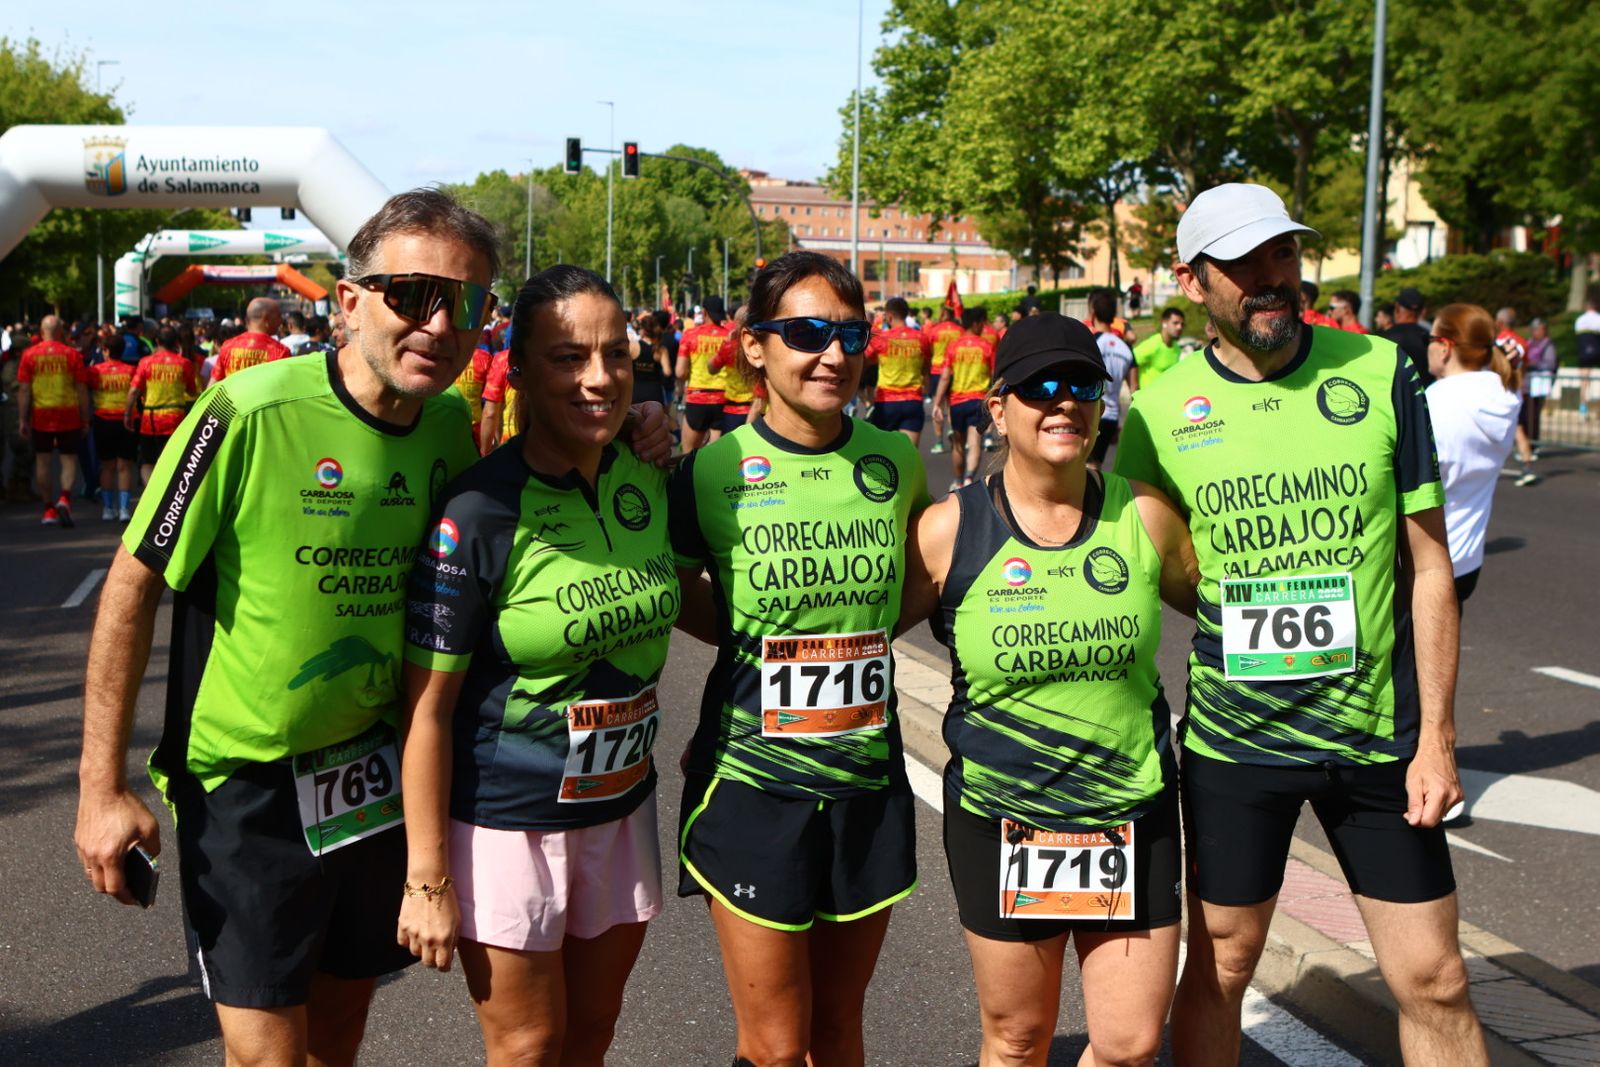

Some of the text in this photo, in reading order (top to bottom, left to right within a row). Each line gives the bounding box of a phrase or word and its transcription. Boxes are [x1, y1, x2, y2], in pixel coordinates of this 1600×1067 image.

[136, 154, 259, 175] Ayuntamiento
[138, 177, 260, 194] de Salamanca
[1171, 419, 1226, 437] CARBAJOSA
[154, 415, 219, 547] CORRECAMINOS
[723, 481, 788, 494] CARBAJOSA
[744, 489, 785, 498] DEPORTE
[1196, 462, 1368, 518] CORRECAMINOS
[300, 489, 355, 499] CARBAJOSA
[741, 518, 896, 556] CORRECAMINOS
[1210, 504, 1365, 555] CARBAJOSA
[749, 553, 897, 592] CARBAJOSA
[1224, 546, 1365, 580] SALAMANCA
[757, 589, 889, 614] SALAMANCA
[987, 587, 1048, 597] CARBAJOSA
[1225, 578, 1346, 603] XIV SAN FERNANDO
[1256, 590, 1316, 602] CARRERA
[564, 586, 680, 648] CARBAJOS
[1241, 605, 1334, 650] 766
[992, 614, 1140, 648] CORRECAMINOS
[767, 641, 799, 660] XIV
[802, 640, 824, 649] SAN
[801, 648, 860, 660] CARRERA
[994, 643, 1136, 673] CARBAJOSA
[770, 660, 885, 707] 1716
[1004, 668, 1128, 687] SALAMANCA
[573, 705, 605, 728] XIV
[576, 715, 658, 774] 1720
[314, 753, 393, 817] 769
[1040, 832, 1096, 844] CARRERA
[1008, 847, 1128, 889] 1719
